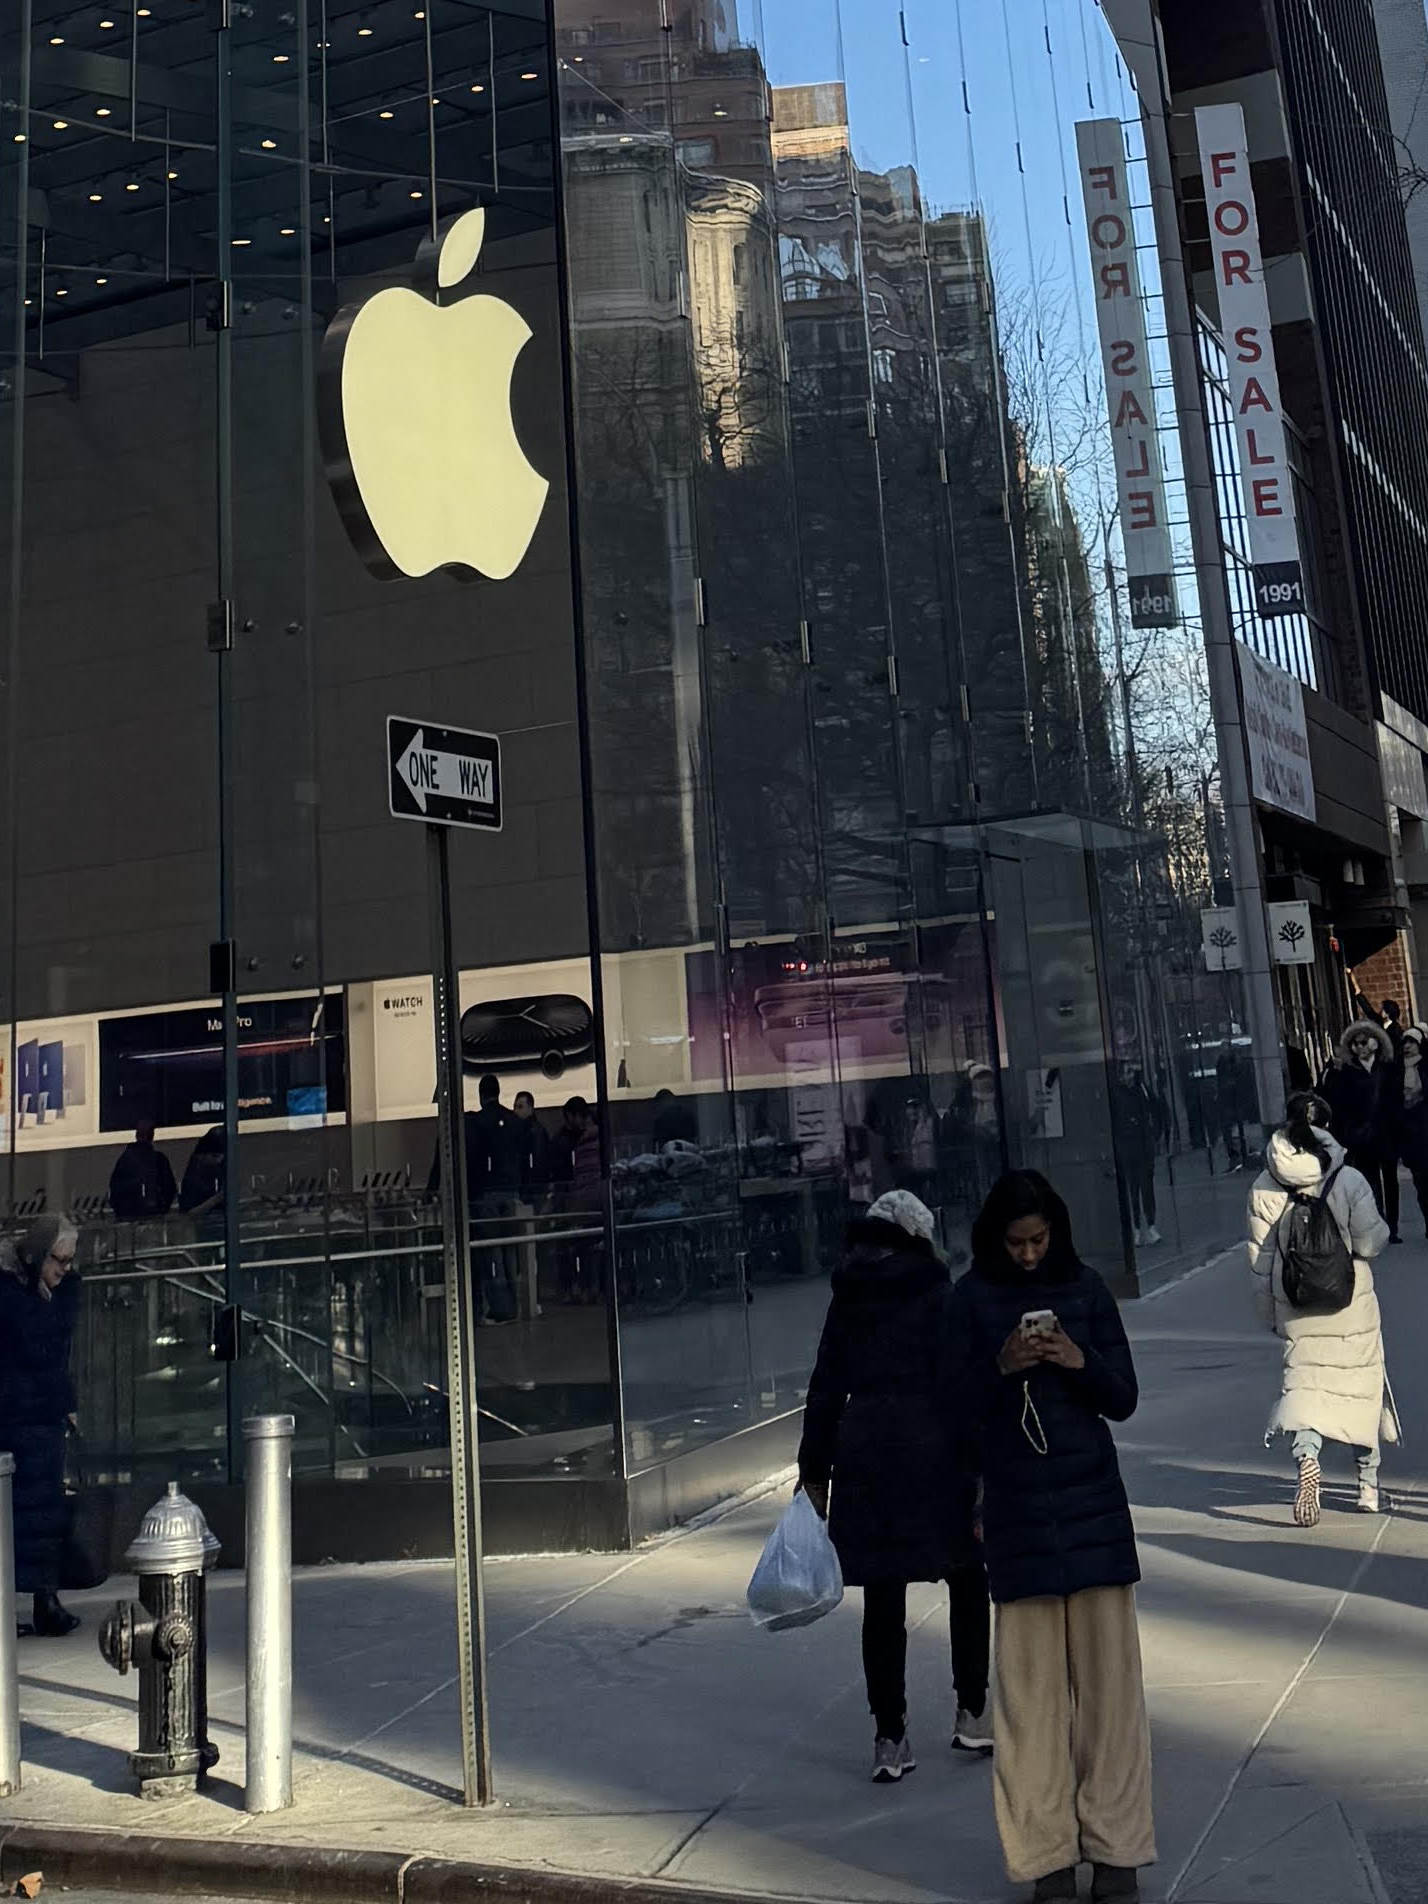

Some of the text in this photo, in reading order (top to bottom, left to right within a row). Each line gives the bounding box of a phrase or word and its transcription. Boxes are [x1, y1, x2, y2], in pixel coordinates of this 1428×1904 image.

[1210, 151, 1283, 517] FOR SALE
[409, 751, 489, 798] ONE WAY
[392, 996, 423, 1009] WATCH
